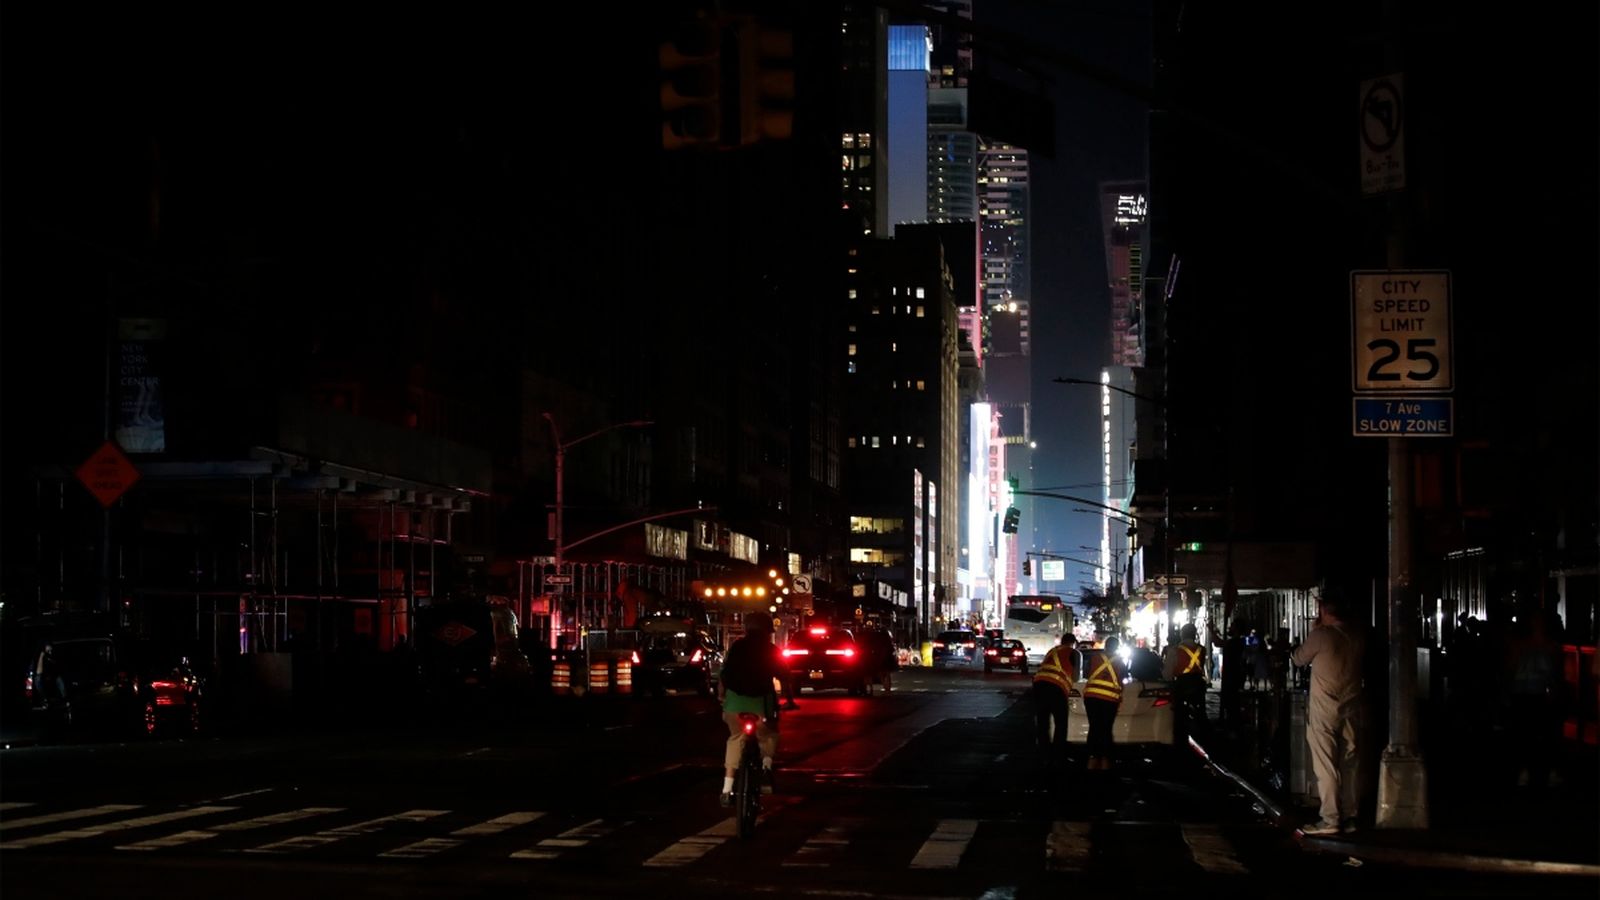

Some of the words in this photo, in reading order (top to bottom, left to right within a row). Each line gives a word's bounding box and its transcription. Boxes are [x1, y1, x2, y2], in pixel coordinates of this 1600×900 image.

[1382, 280, 1421, 294] CITY
[1373, 299, 1430, 313] SPEED
[1380, 318, 1425, 332] LIMIT
[121, 344, 143, 352] NEW
[121, 354, 148, 363] YORK
[1367, 338, 1440, 381] 25
[121, 366, 144, 375] CITY
[1385, 402, 1391, 414] 7
[1398, 402, 1421, 415] Ave
[1360, 419, 1401, 432] SLOW
[1406, 419, 1447, 432] ZONE
